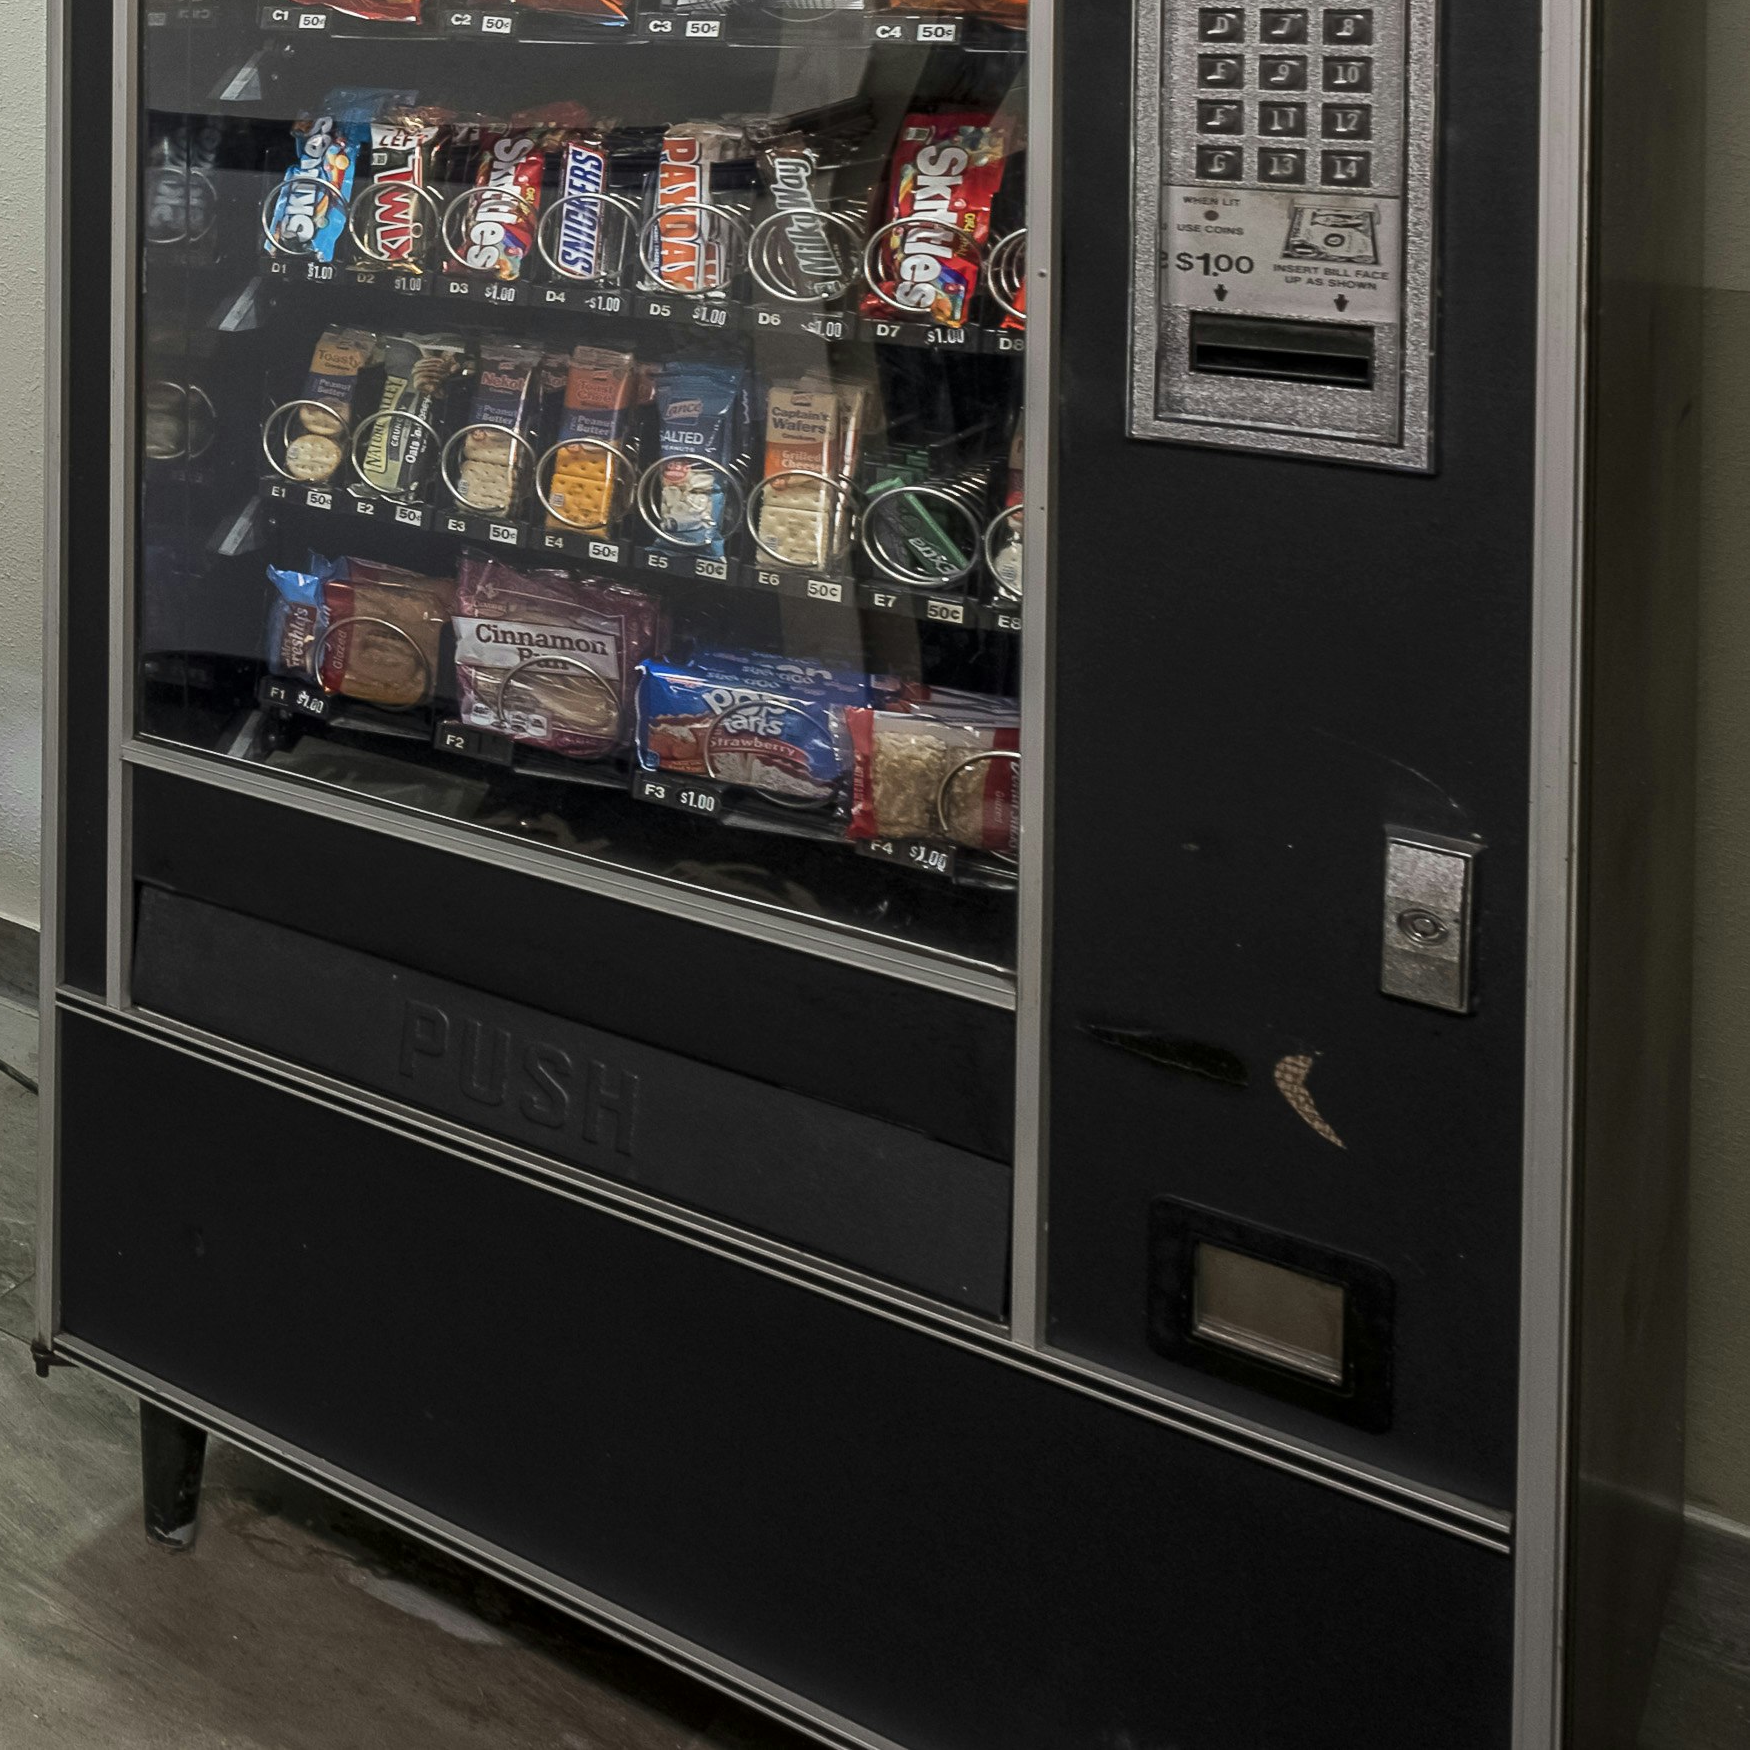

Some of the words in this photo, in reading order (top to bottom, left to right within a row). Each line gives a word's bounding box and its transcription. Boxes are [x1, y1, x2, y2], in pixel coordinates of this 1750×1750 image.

[272, 10, 289, 21] C1
[451, 14, 472, 25] C2
[649, 20, 672, 33] C3
[876, 25, 901, 39] C4
[1336, 65, 1360, 84] 10
[1272, 108, 1295, 130] 11
[1336, 111, 1359, 132] 12
[1270, 155, 1294, 176] 13
[1335, 158, 1358, 179] 14
[1183, 196, 1219, 205] WHEN
[1222, 198, 1241, 206] LIT
[561, 149, 603, 275] SNICKERS
[659, 137, 700, 291] PAYDAY
[896, 145, 969, 308] Skittles
[1177, 223, 1201, 232] USE
[1204, 225, 1244, 235] COINS
[271, 263, 286, 273] D1
[1175, 251, 1255, 277] $1.00
[357, 274, 375, 284] D2
[1273, 264, 1321, 277] INSERT
[1324, 267, 1351, 278] BILL
[1355, 269, 1390, 280] FACE
[450, 282, 469, 293] D3
[1285, 276, 1301, 285] UP
[1306, 277, 1324, 286] AS
[1328, 278, 1378, 290] SHOWN
[546, 291, 566, 302] D4
[649, 304, 671, 316] D5
[758, 313, 781, 325] D6
[877, 324, 900, 337] D7
[1000, 337, 1025, 351] D8
[318, 350, 361, 367] Toasty
[772, 407, 829, 421] Captain's
[577, 416, 615, 427] Peanut
[772, 418, 826, 434] Wafers
[576, 425, 611, 435] Butter
[272, 486, 286, 497] E1
[357, 503, 374, 515] E2
[448, 519, 465, 531] E3
[545, 536, 564, 548] E4
[648, 555, 668, 568] E5
[758, 572, 780, 585] E6
[874, 593, 897, 608] E7
[998, 616, 1022, 630] E8
[476, 623, 609, 656] Cinnamon
[270, 687, 286, 699] F1
[723, 713, 786, 736] tarts
[446, 734, 465, 749] F2
[645, 783, 666, 799] F3
[680, 791, 715, 812] $1.00
[399, 1000, 641, 1156] PUSH
